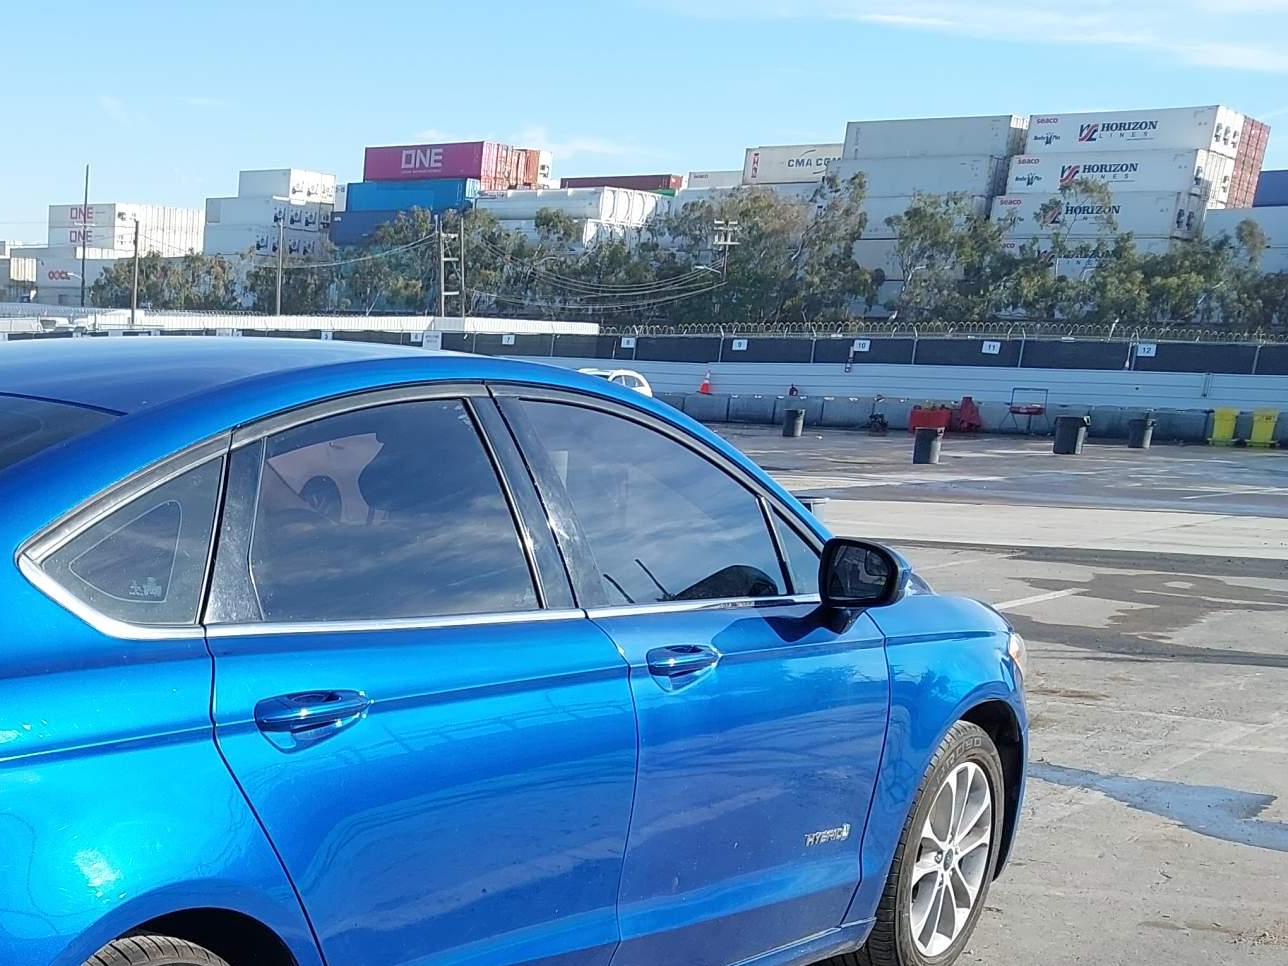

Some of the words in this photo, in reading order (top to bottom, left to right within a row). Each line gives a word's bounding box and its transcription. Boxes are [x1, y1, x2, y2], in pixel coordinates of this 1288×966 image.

[1101, 120, 1158, 132] HORIZON
[1099, 131, 1149, 139] LINES
[401, 148, 444, 169] ONE
[787, 158, 812, 168] CMA
[1082, 162, 1139, 174] HORIZON
[70, 207, 94, 220] ONE
[69, 230, 93, 243] ONE
[857, 341, 867, 350] 10
[987, 343, 998, 352] 11
[1142, 346, 1153, 355] 12
